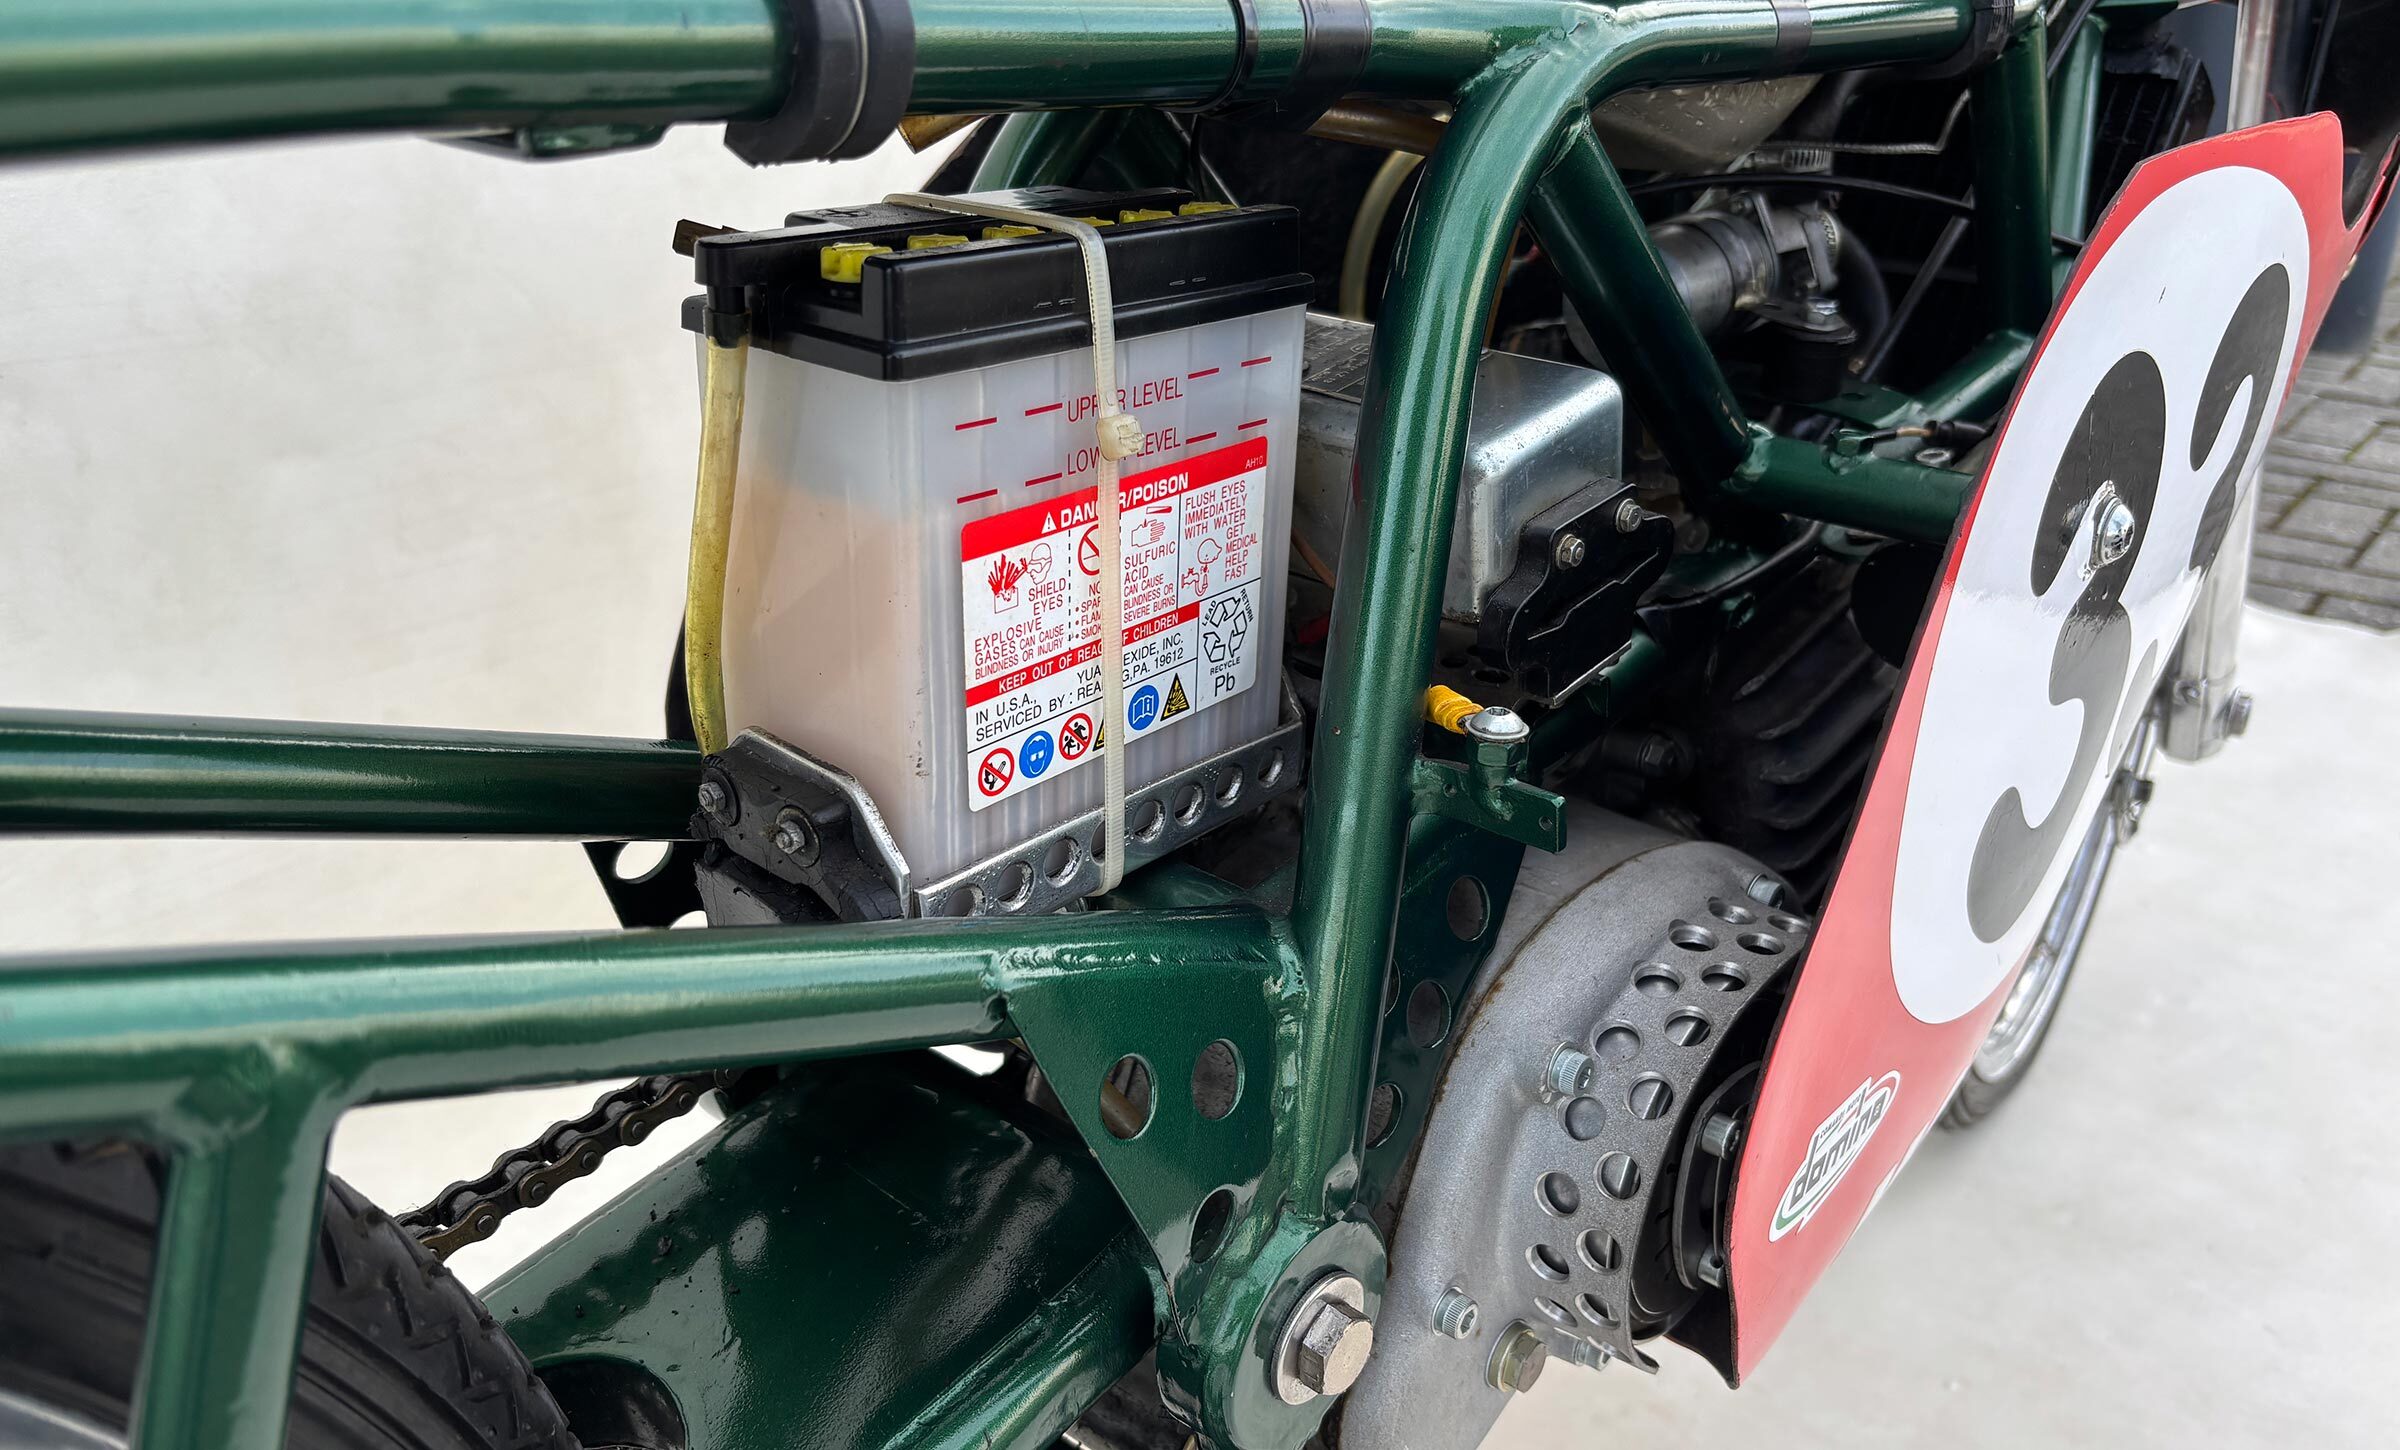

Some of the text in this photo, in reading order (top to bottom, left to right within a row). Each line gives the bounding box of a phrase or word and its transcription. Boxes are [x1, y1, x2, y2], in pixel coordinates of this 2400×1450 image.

[1067, 376, 1184, 423] UPPR LEVEL
[1245, 455, 1265, 470] AH10
[1060, 471, 1190, 530] DANR/POISON
[1185, 479, 1246, 511] FLUSH EYES
[1185, 493, 1248, 526] IMMEDIATELY
[1184, 508, 1246, 540] WITH WATER
[1226, 523, 1246, 540] GET
[1124, 540, 1176, 570] SULFURIC
[1225, 532, 1258, 554] MEDICAL
[1224, 563, 1248, 582] FAST
[1225, 549, 1249, 568] HELP
[1028, 577, 1067, 602] SHIELD
[1123, 565, 1149, 586] ACID
[1123, 573, 1165, 598] CAN CAUSE
[1033, 594, 1064, 616] EYES
[1123, 583, 1174, 611] BLINDNESS OR
[1123, 595, 1176, 624] SEVERE BURNS
[1240, 588, 1255, 623] RETURN
[1202, 600, 1217, 627] LEAD
[974, 616, 1042, 653] EXPLOSIVE
[974, 624, 1065, 667] GASES CAN CAUSE
[975, 637, 1064, 680] BLINDNESS OR INJURY
[998, 671, 1027, 694] KEEP
[1032, 660, 1054, 680] OUT
[1058, 653, 1073, 670] OF
[1077, 642, 1103, 663] REAC
[1133, 612, 1179, 640] CHILDREN
[1210, 656, 1241, 676] RECYCLE
[976, 708, 989, 726] IN
[996, 693, 1037, 717] U.S.A.,
[1162, 632, 1184, 651] INC.
[1214, 672, 1236, 697] Pb
[976, 704, 1042, 742] SERVICED
[1155, 647, 1184, 669] 19612
[1789, 1089, 1888, 1212] domino
